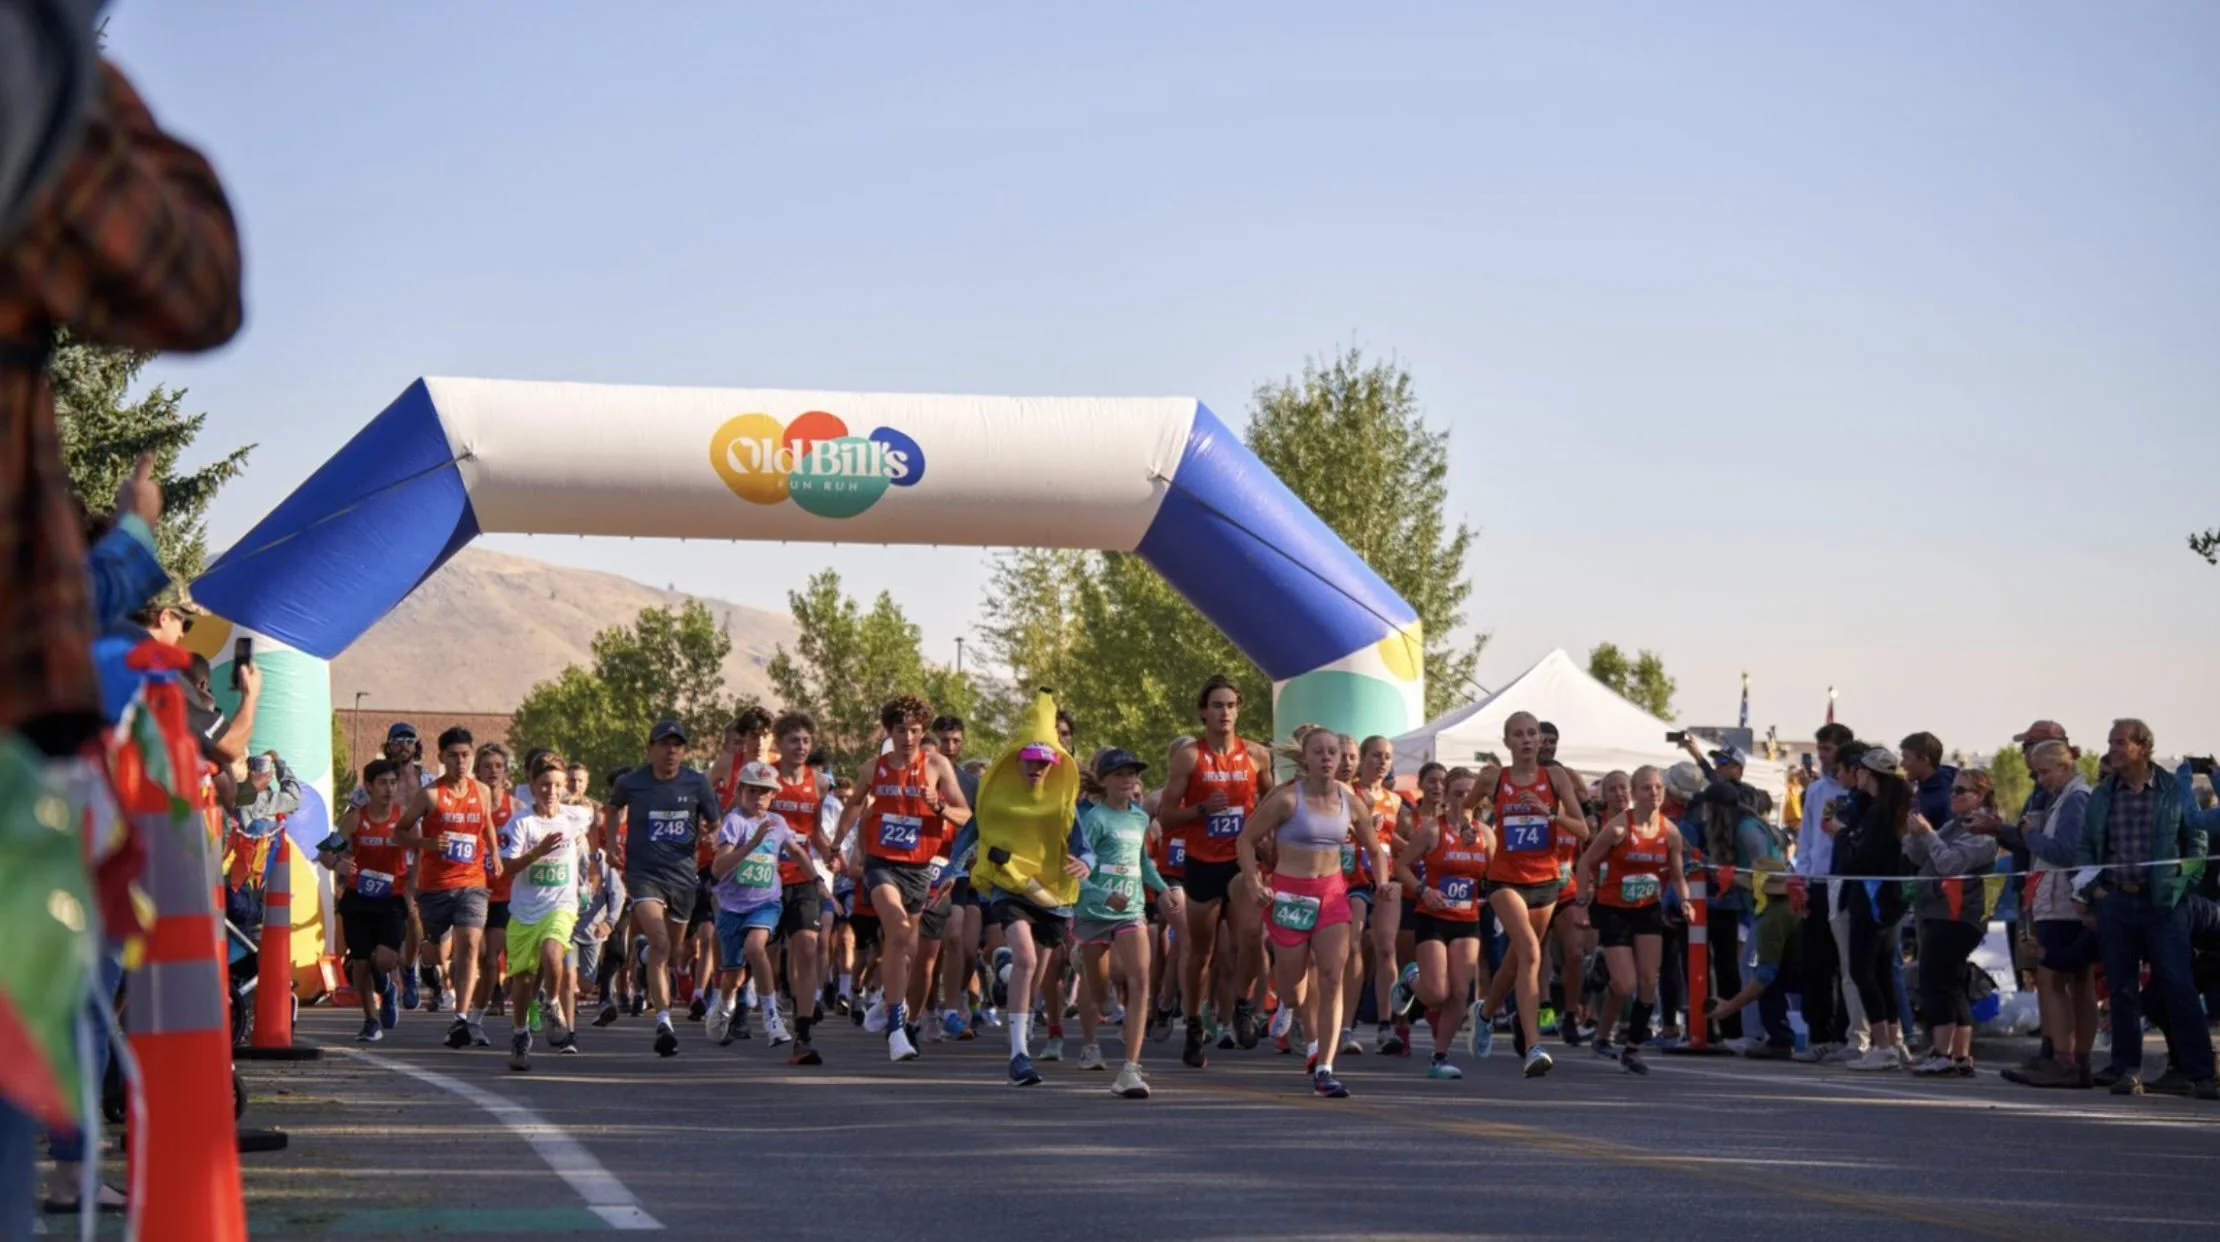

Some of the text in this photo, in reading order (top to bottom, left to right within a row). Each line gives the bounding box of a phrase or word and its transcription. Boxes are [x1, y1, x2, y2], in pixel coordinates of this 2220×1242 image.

[726, 437, 909, 479] Old Bill's
[777, 479, 858, 491] FUN RUN
[654, 820, 685, 836] 248
[1210, 817, 1240, 832] 121
[884, 825, 916, 844] 224
[1515, 827, 1540, 845] 74
[447, 840, 473, 858] 119
[535, 866, 567, 882] 406
[742, 864, 772, 882] 430
[365, 879, 385, 893] 97
[1103, 878, 1135, 897] 446
[1277, 905, 1313, 925] 447
